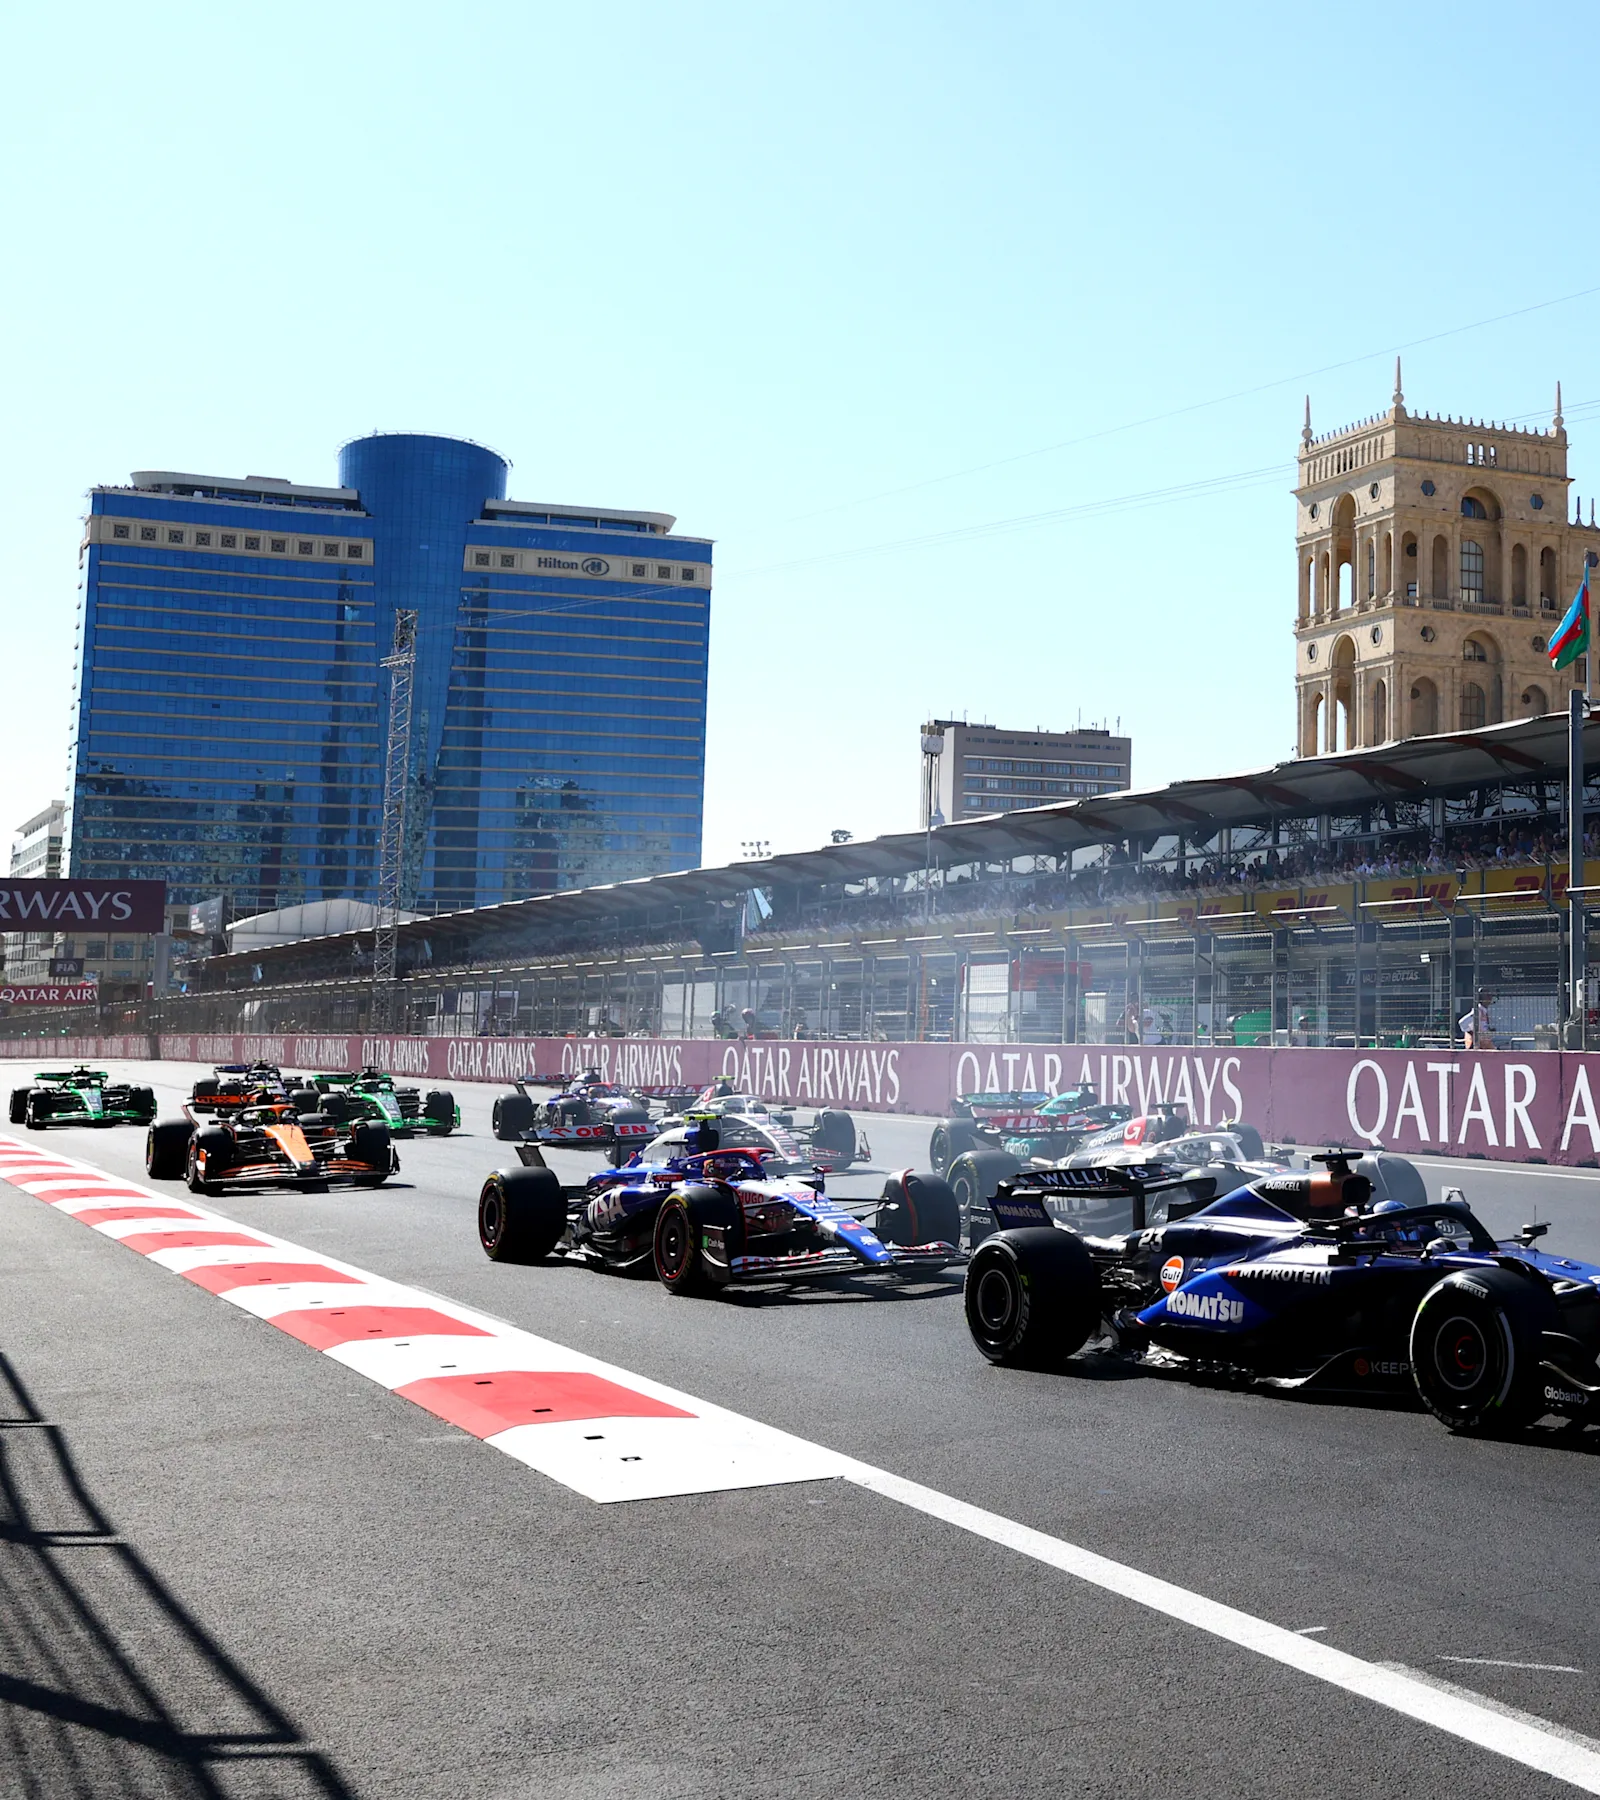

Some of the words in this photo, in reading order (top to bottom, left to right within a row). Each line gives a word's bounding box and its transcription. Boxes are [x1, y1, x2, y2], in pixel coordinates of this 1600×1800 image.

[538, 557, 578, 570] Hilton
[1388, 883, 1453, 912] DHL
[1513, 872, 1570, 902] DH
[56, 963, 77, 972] FIA
[3, 988, 60, 1003] QATAR
[295, 1038, 318, 1066] QATAR
[319, 1039, 349, 1068] AIRWAYS
[362, 1039, 391, 1069] QATAR
[392, 1040, 429, 1073] AIRWAYS
[448, 1041, 482, 1077] QATAR
[485, 1042, 536, 1078] AIRWAYS
[561, 1044, 609, 1083] QATAR
[610, 1044, 682, 1086] AIRWAYS
[722, 1046, 791, 1097] QATAR
[796, 1047, 900, 1104] AIRWAYS
[956, 1051, 1062, 1097] QATAR
[1078, 1053, 1243, 1126] AIRWAYS
[1346, 1059, 1542, 1149] QATAR
[576, 1125, 648, 1137] OREN
[1038, 1166, 1149, 1185] WILLIS
[1265, 1180, 1301, 1192] DURACELL
[739, 1193, 764, 1204] HUGO
[587, 1187, 628, 1232] VISA
[996, 1204, 1044, 1219] KOMATSU
[1138, 1228, 1168, 1252] 23
[1161, 1268, 1182, 1283] Gulf
[1239, 1269, 1333, 1285] MYPROTEIN
[1455, 1279, 1489, 1300] PIRELLI
[1167, 1290, 1245, 1324] KOMATSU
[1370, 1361, 1412, 1375] KEEP
[1544, 1386, 1582, 1405] Globant
